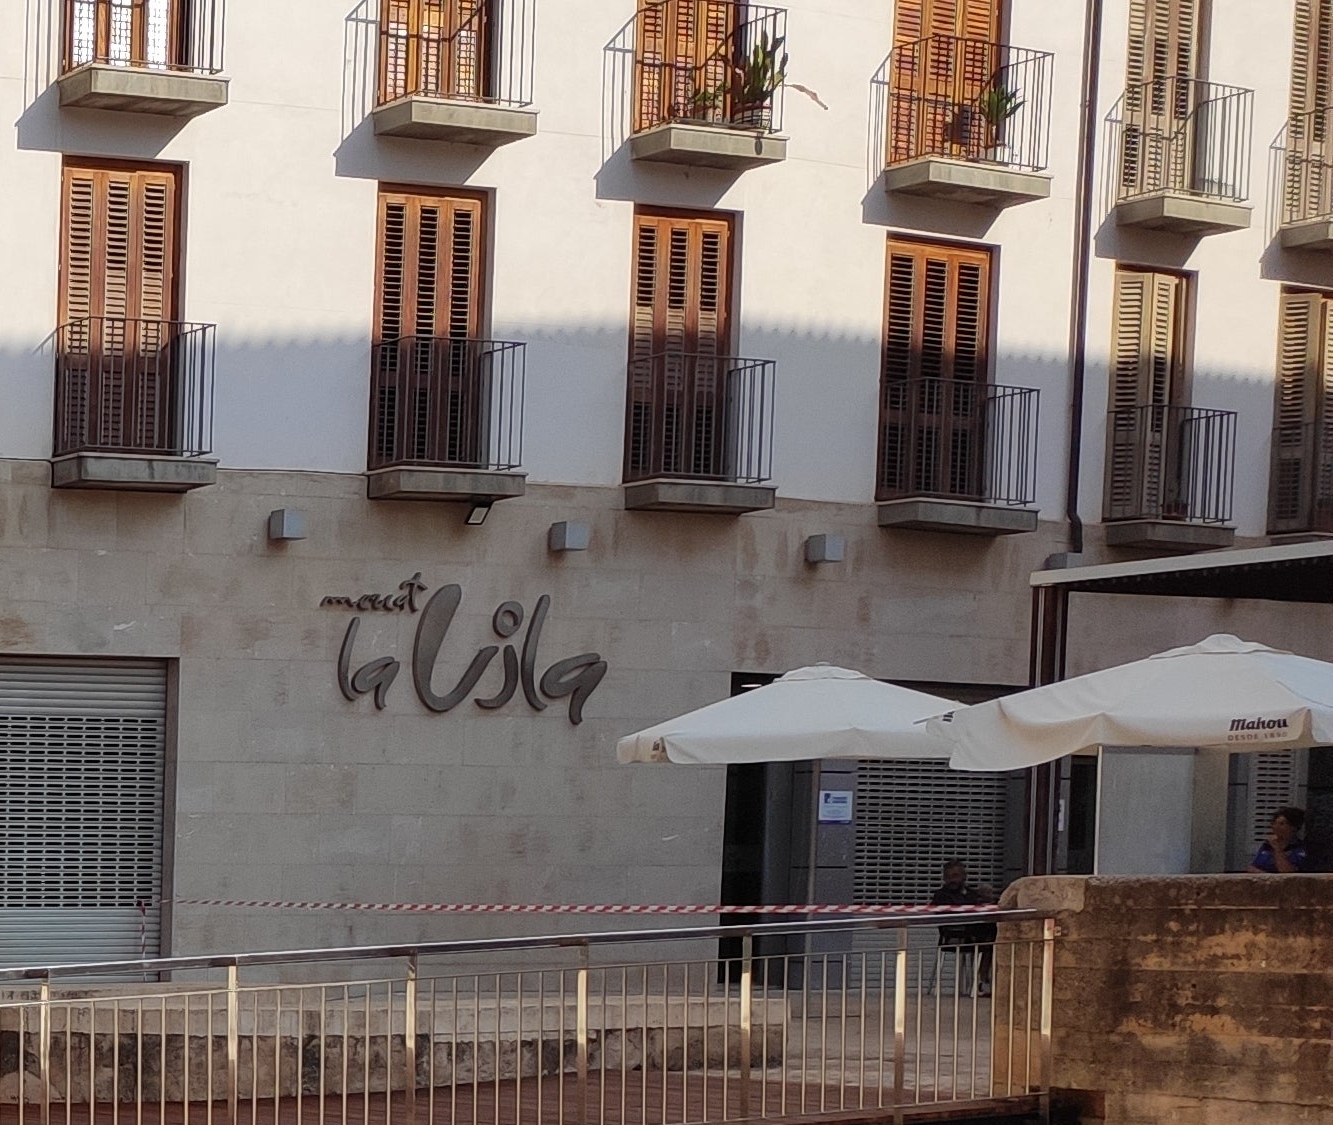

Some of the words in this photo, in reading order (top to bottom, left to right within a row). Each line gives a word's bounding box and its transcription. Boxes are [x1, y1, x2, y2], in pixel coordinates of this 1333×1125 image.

[337, 616, 400, 710] la
[1229, 717, 1289, 731] Mahou
[1227, 733, 1259, 741] DESDE
